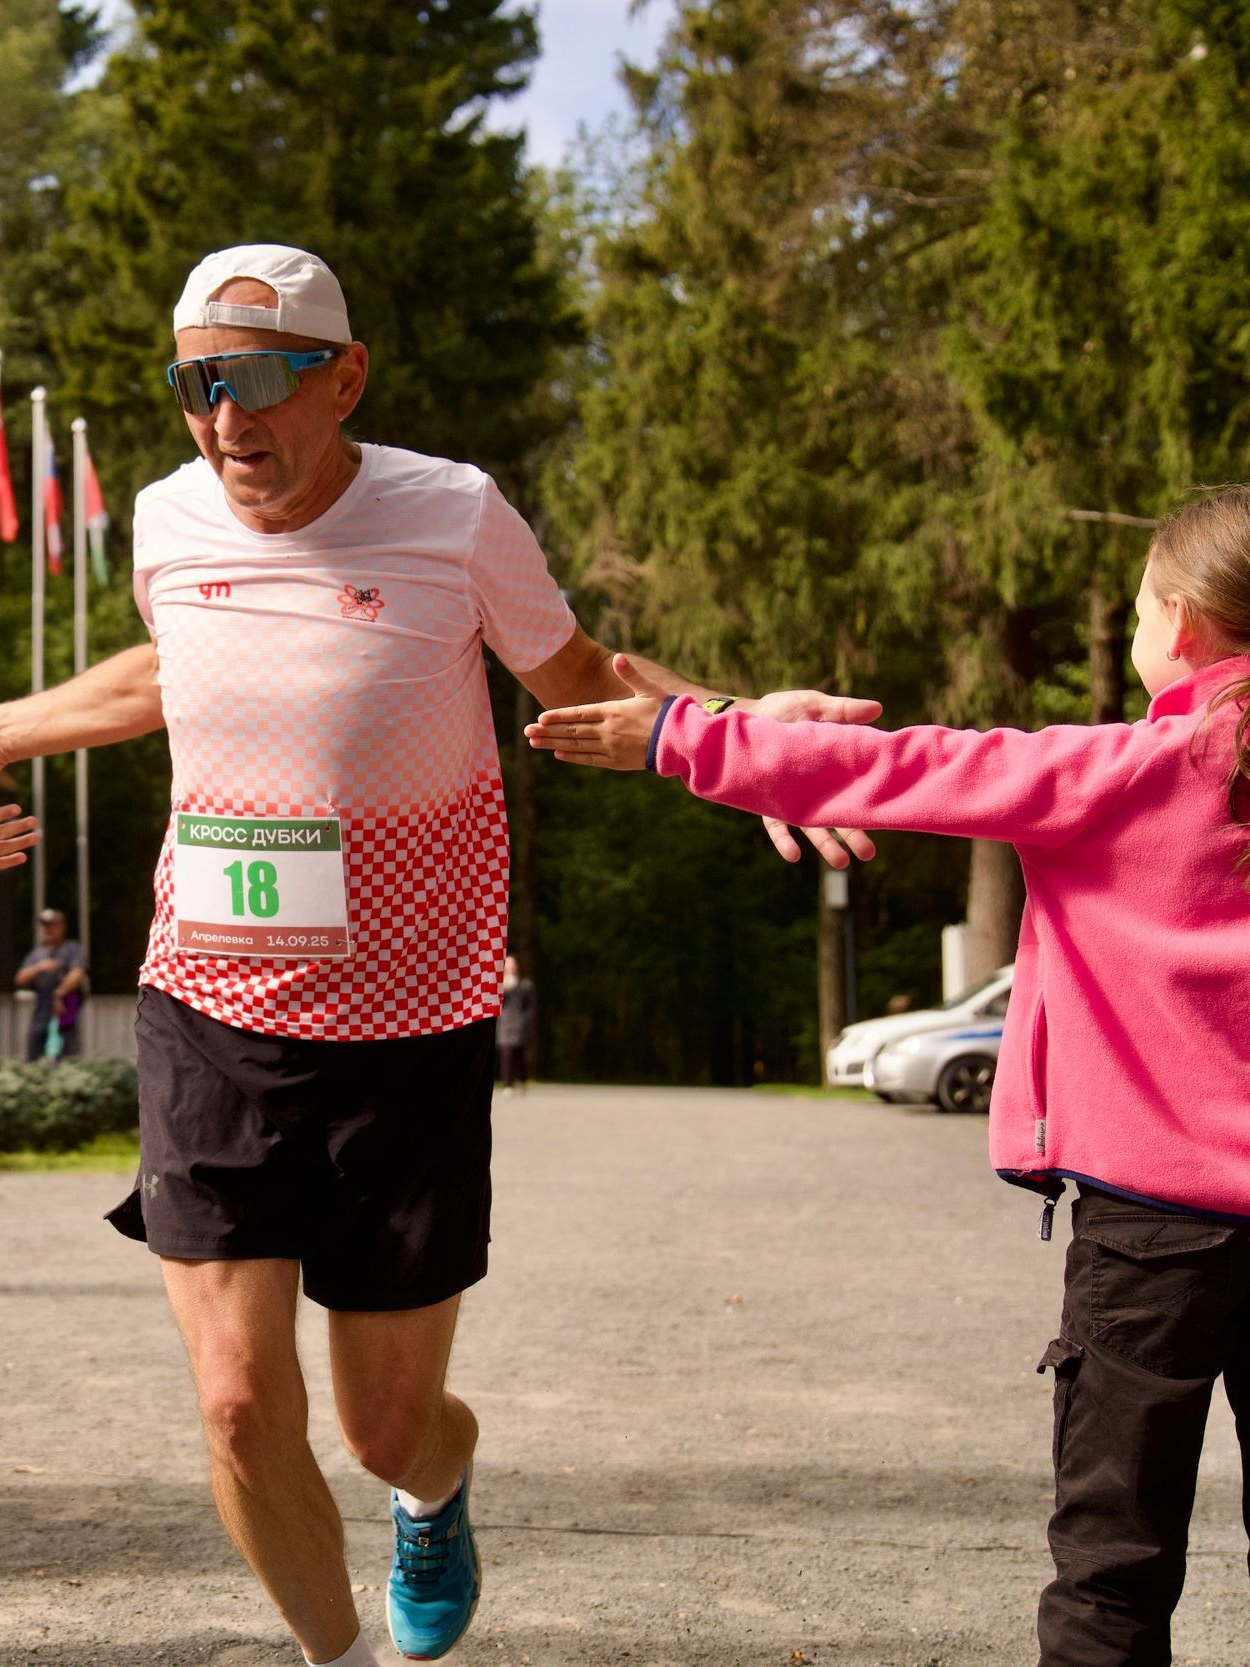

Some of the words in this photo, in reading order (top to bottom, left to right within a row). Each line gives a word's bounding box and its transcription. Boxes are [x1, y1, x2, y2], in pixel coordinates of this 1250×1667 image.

[190, 823, 248, 844] КРОСС
[252, 828, 321, 847] ДУБКИ
[223, 860, 280, 918] 18
[191, 930, 254, 945] Апрелевка
[266, 935, 329, 947] 14.09.25
